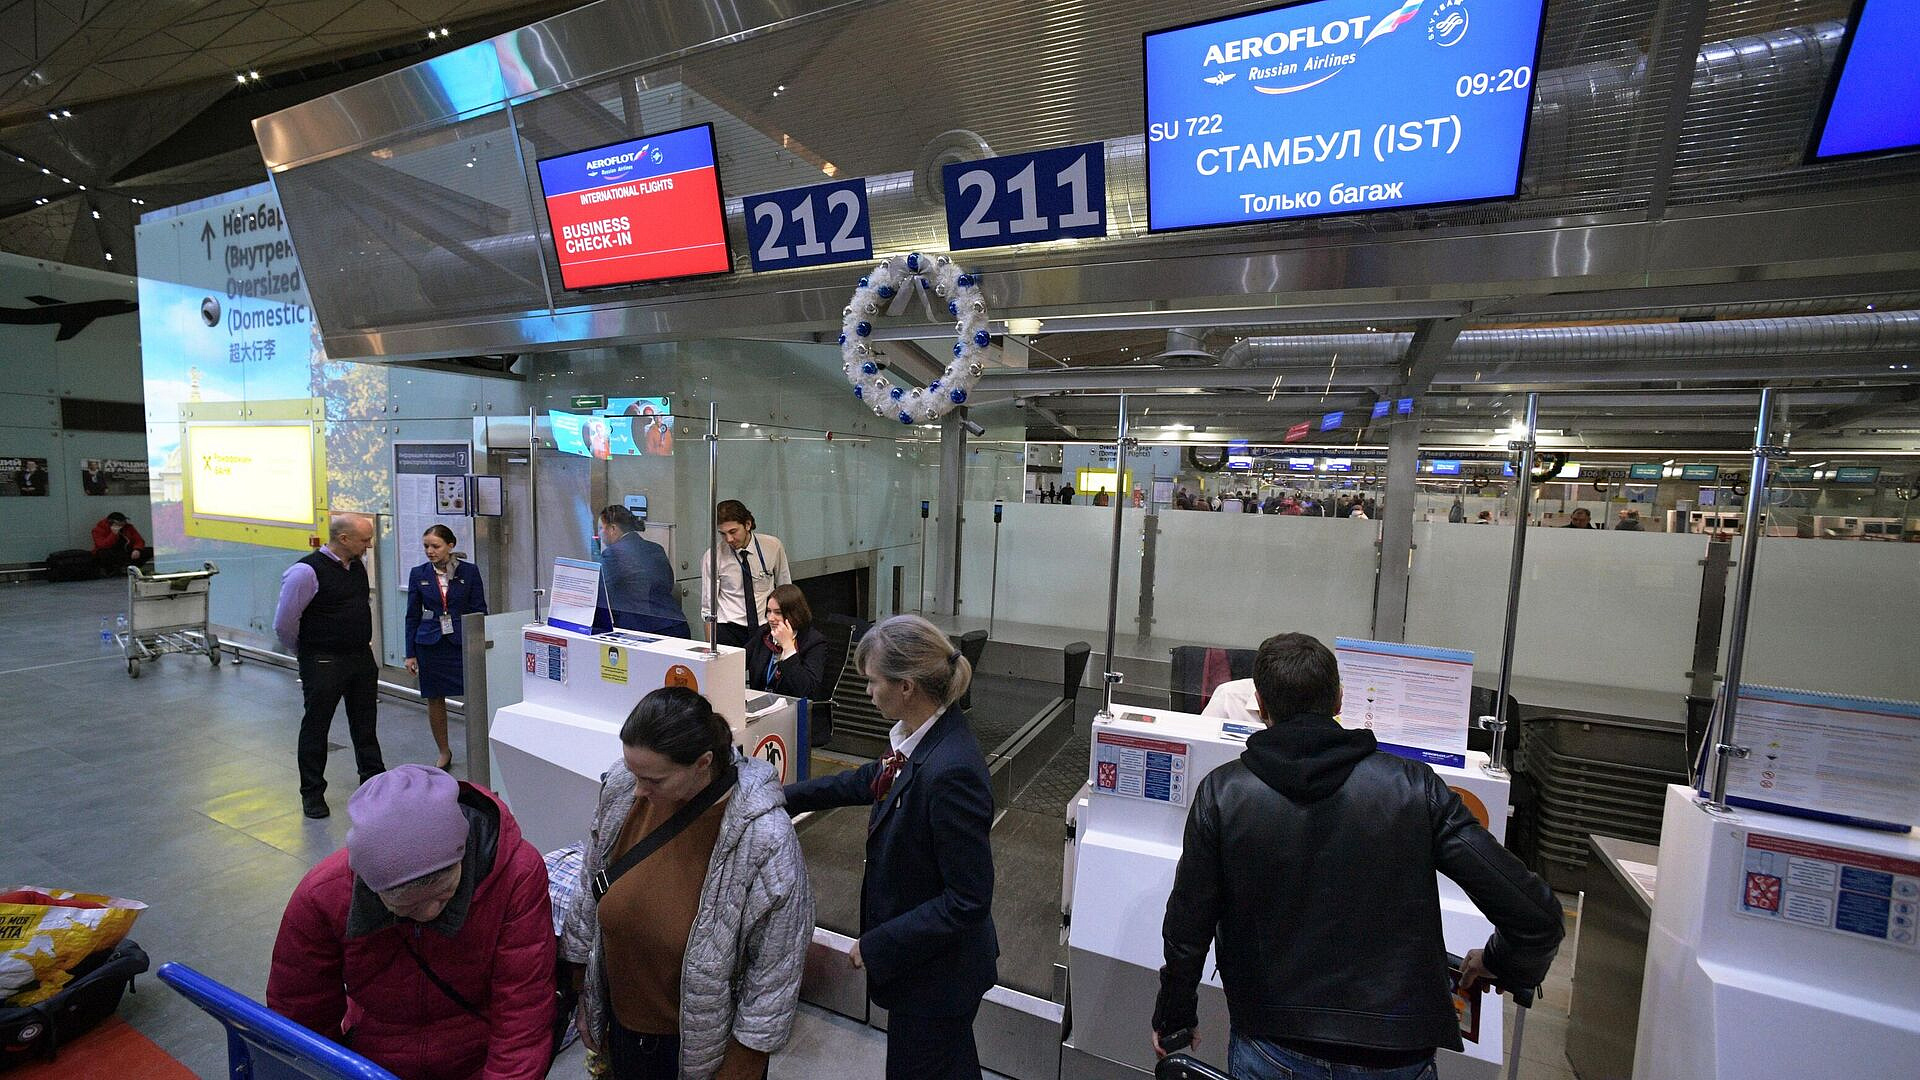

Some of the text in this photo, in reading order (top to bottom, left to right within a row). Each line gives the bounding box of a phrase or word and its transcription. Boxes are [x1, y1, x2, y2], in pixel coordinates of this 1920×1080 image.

[1203, 15, 1371, 66] AEROFLOT
[1248, 52, 1356, 81] Russian Airlines
[1455, 66, 1531, 98] 09:20
[1150, 114, 1223, 142] SU 722
[586, 152, 635, 171] AEROFLOT
[1196, 115, 1462, 176] СТАМБУЛ (IST)
[580, 178, 674, 205] INTERNATIONAL FLIGHTS
[957, 152, 1100, 240] 211
[1239, 180, 1404, 214] Только багаж
[562, 216, 630, 239] BUSINESS
[753, 189, 865, 262] 212
[565, 232, 632, 254] CHECK-IN
[226, 266, 300, 299] Oversized
[228, 300, 305, 336] (Domestic
